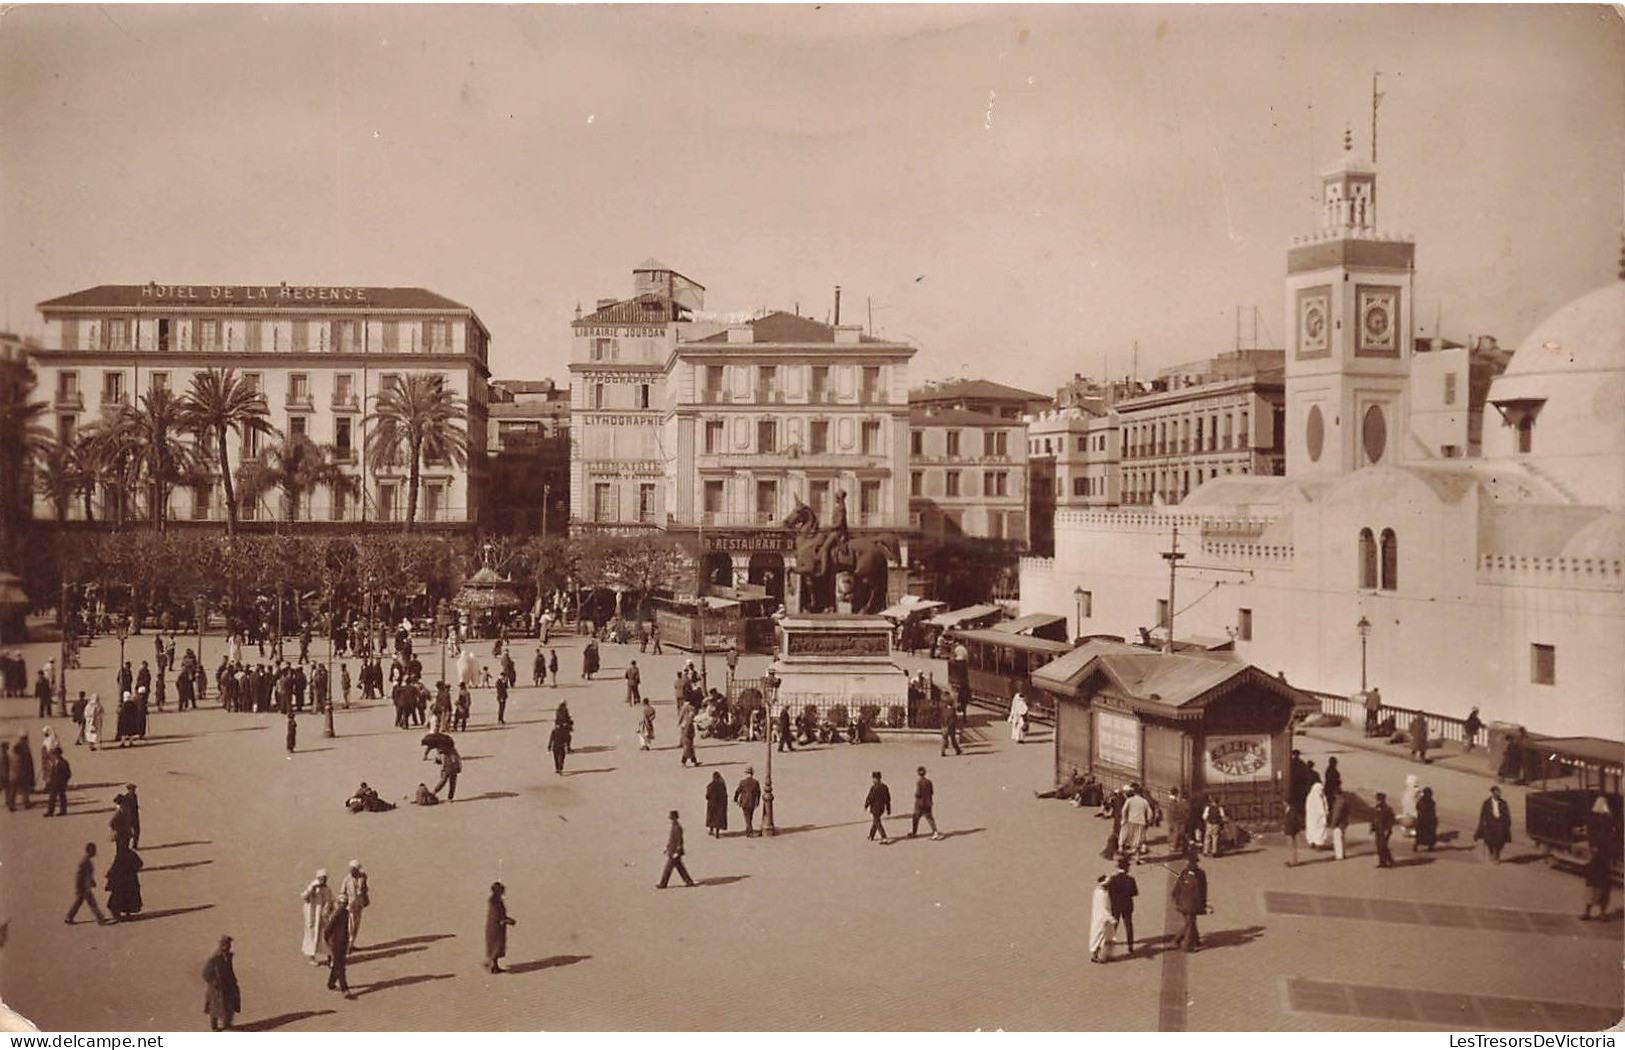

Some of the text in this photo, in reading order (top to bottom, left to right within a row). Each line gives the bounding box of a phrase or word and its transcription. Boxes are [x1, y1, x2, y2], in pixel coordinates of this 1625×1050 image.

[142, 286, 198, 298] HOTEL
[211, 286, 233, 298] DE
[247, 287, 268, 298] LA
[575, 327, 665, 337] LIBRAIRIE JOURDAN
[585, 415, 665, 425] LITHOGRAPHIE
